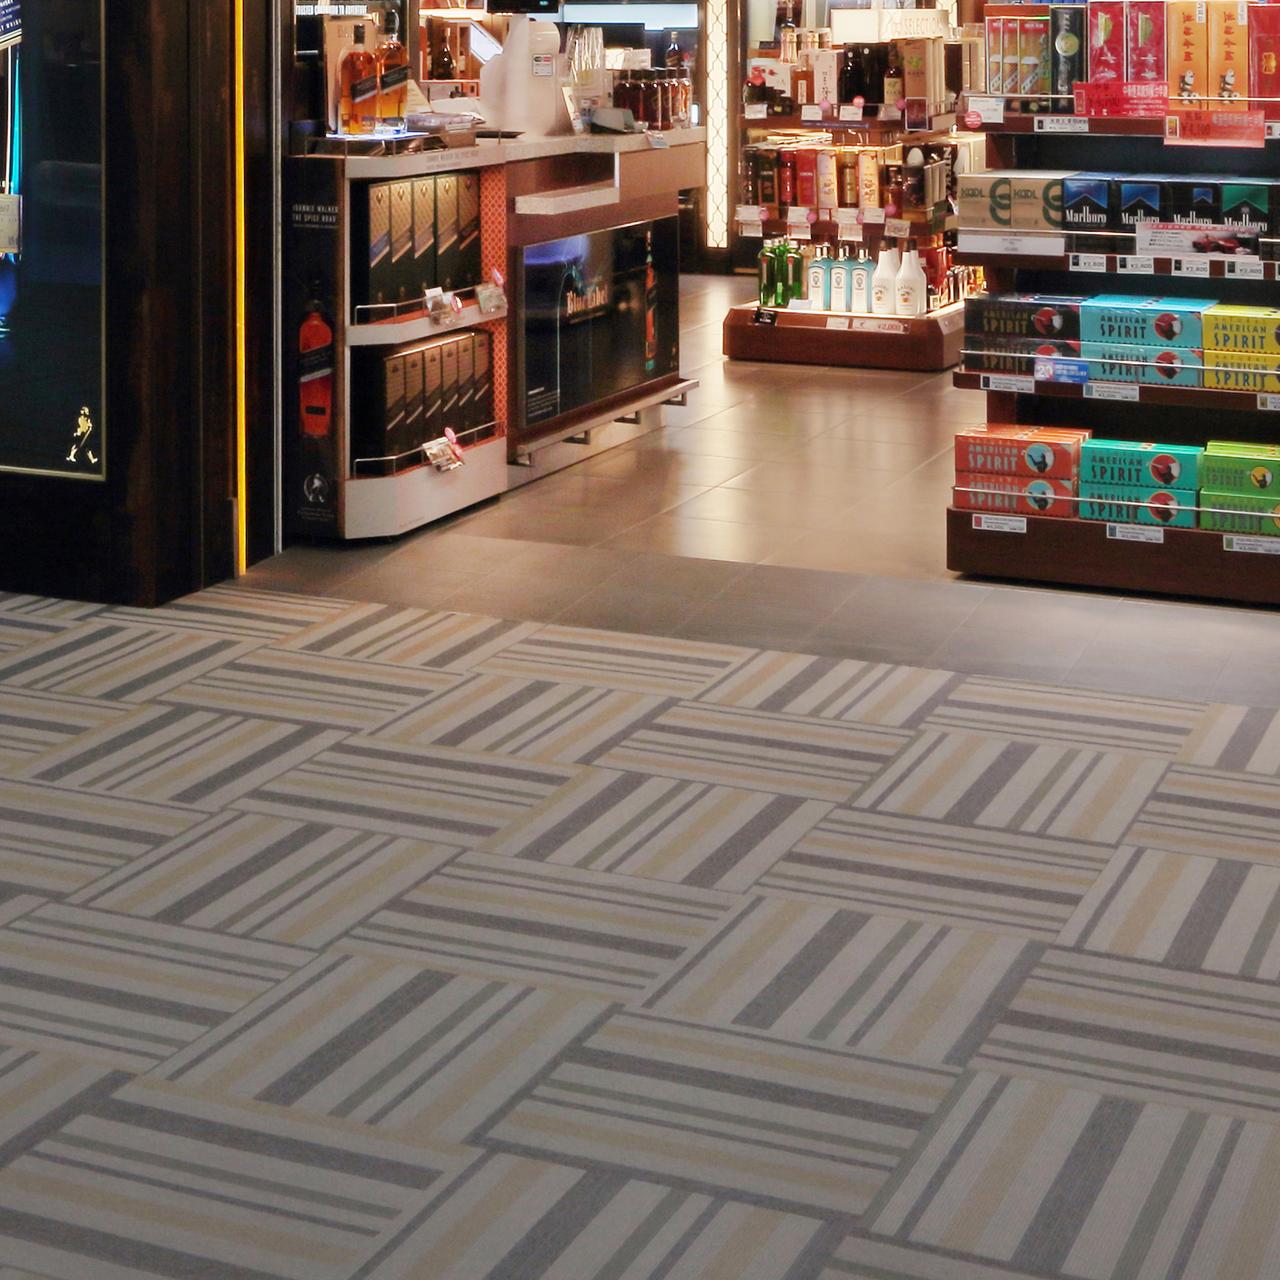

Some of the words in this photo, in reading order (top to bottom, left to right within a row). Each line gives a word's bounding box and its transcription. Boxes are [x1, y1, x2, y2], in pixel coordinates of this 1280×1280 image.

[1065, 206, 1107, 224] Marlboro
[1224, 214, 1268, 232] Marlboro
[983, 320, 1028, 334] SPIRIT
[1101, 315, 1147, 325] AMERICAN
[1100, 323, 1147, 339] SPIRIT
[1214, 324, 1267, 334] AMERICAN
[1214, 334, 1266, 350] SPIRIT
[968, 444, 1018, 455] AMERICAN
[968, 453, 1018, 470] SPIRIT
[1092, 456, 1142, 466] AMERICAN
[1091, 465, 1142, 482] SPIRIT
